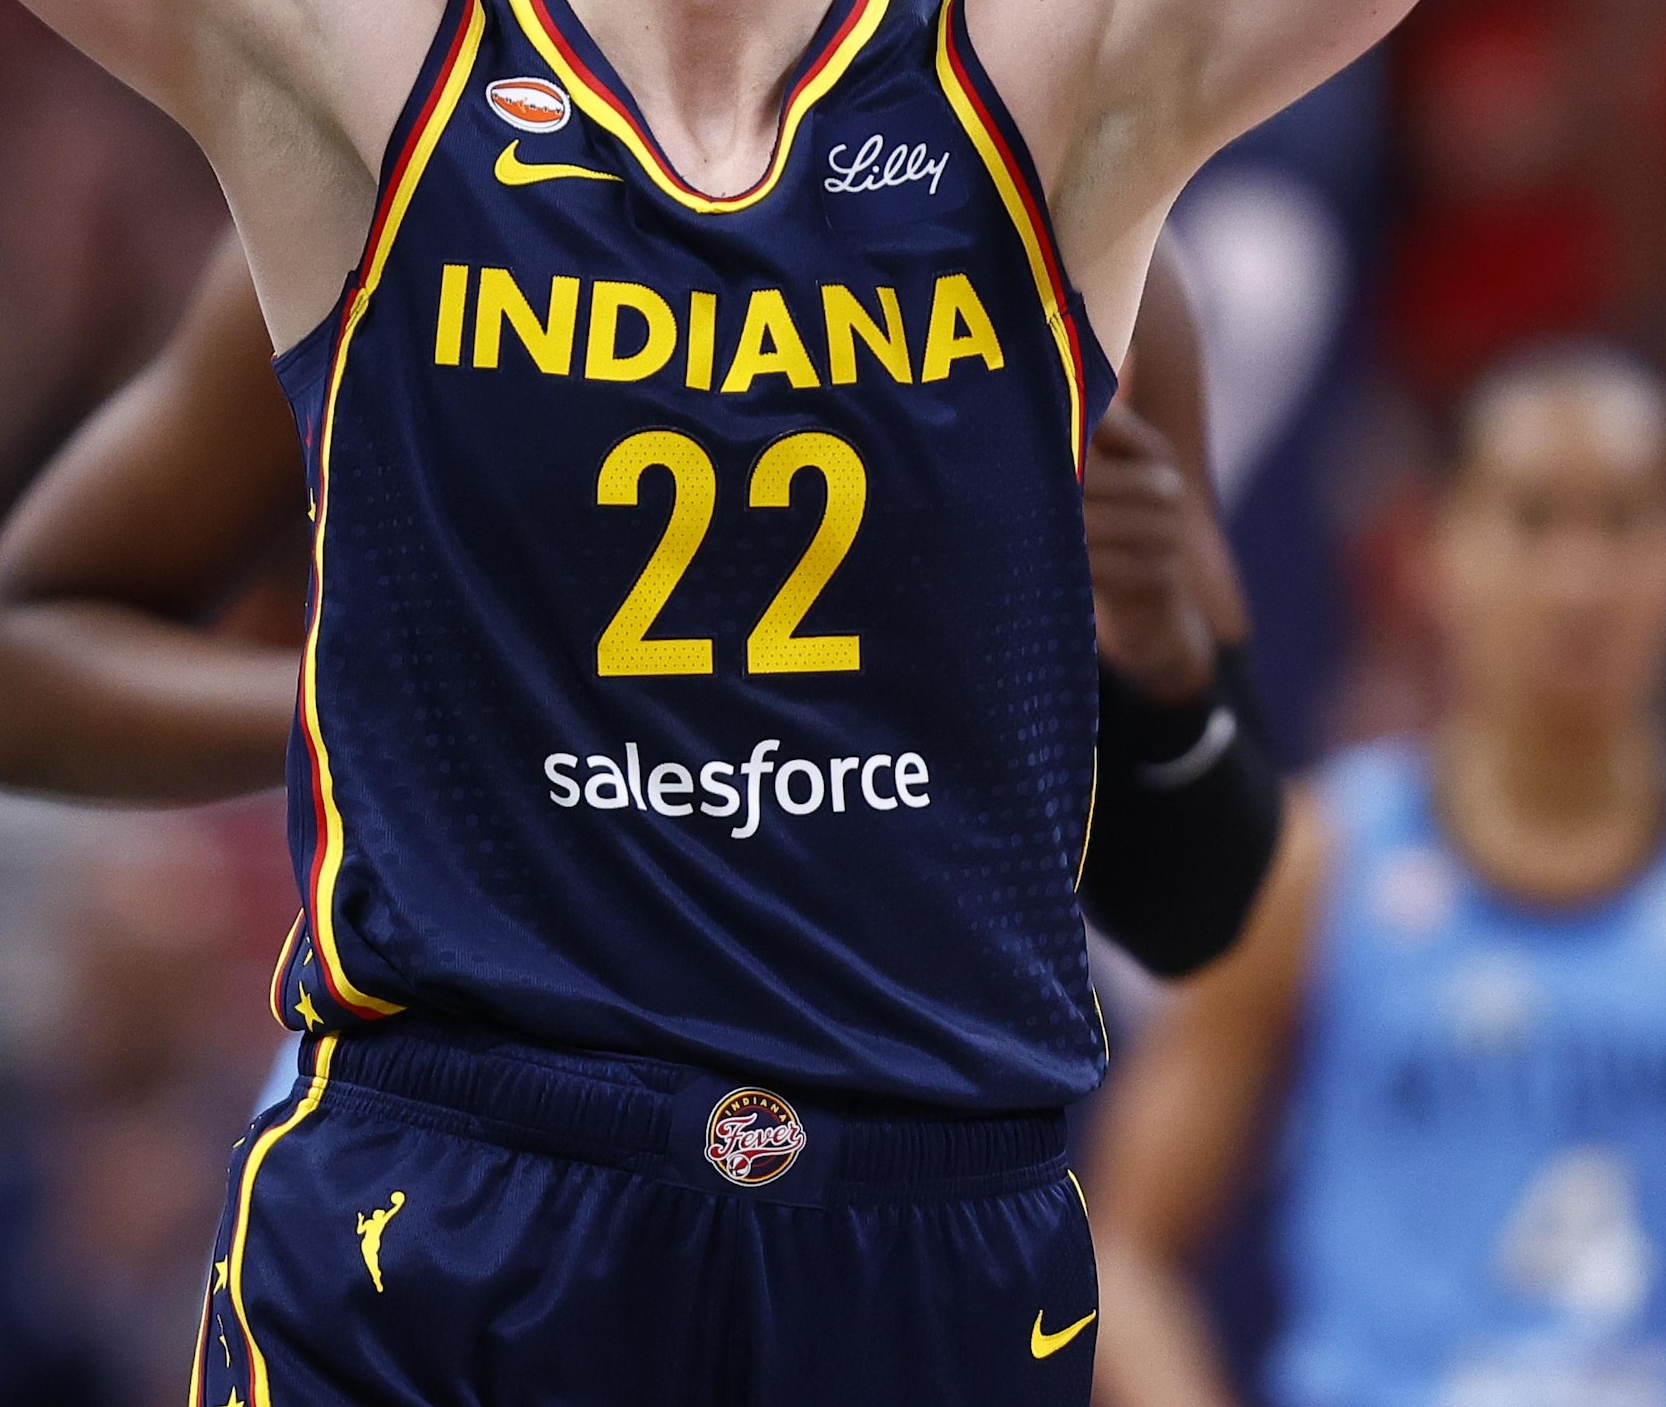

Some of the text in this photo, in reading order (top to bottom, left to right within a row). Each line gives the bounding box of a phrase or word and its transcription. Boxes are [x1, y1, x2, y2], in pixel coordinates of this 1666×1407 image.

[824, 134, 950, 195] Lilly
[434, 264, 1005, 393] INDIANA
[596, 430, 867, 677] 22
[544, 739, 931, 839] salesforce
[708, 1113, 804, 1161] Fever
[725, 1096, 787, 1123] INDIANA
